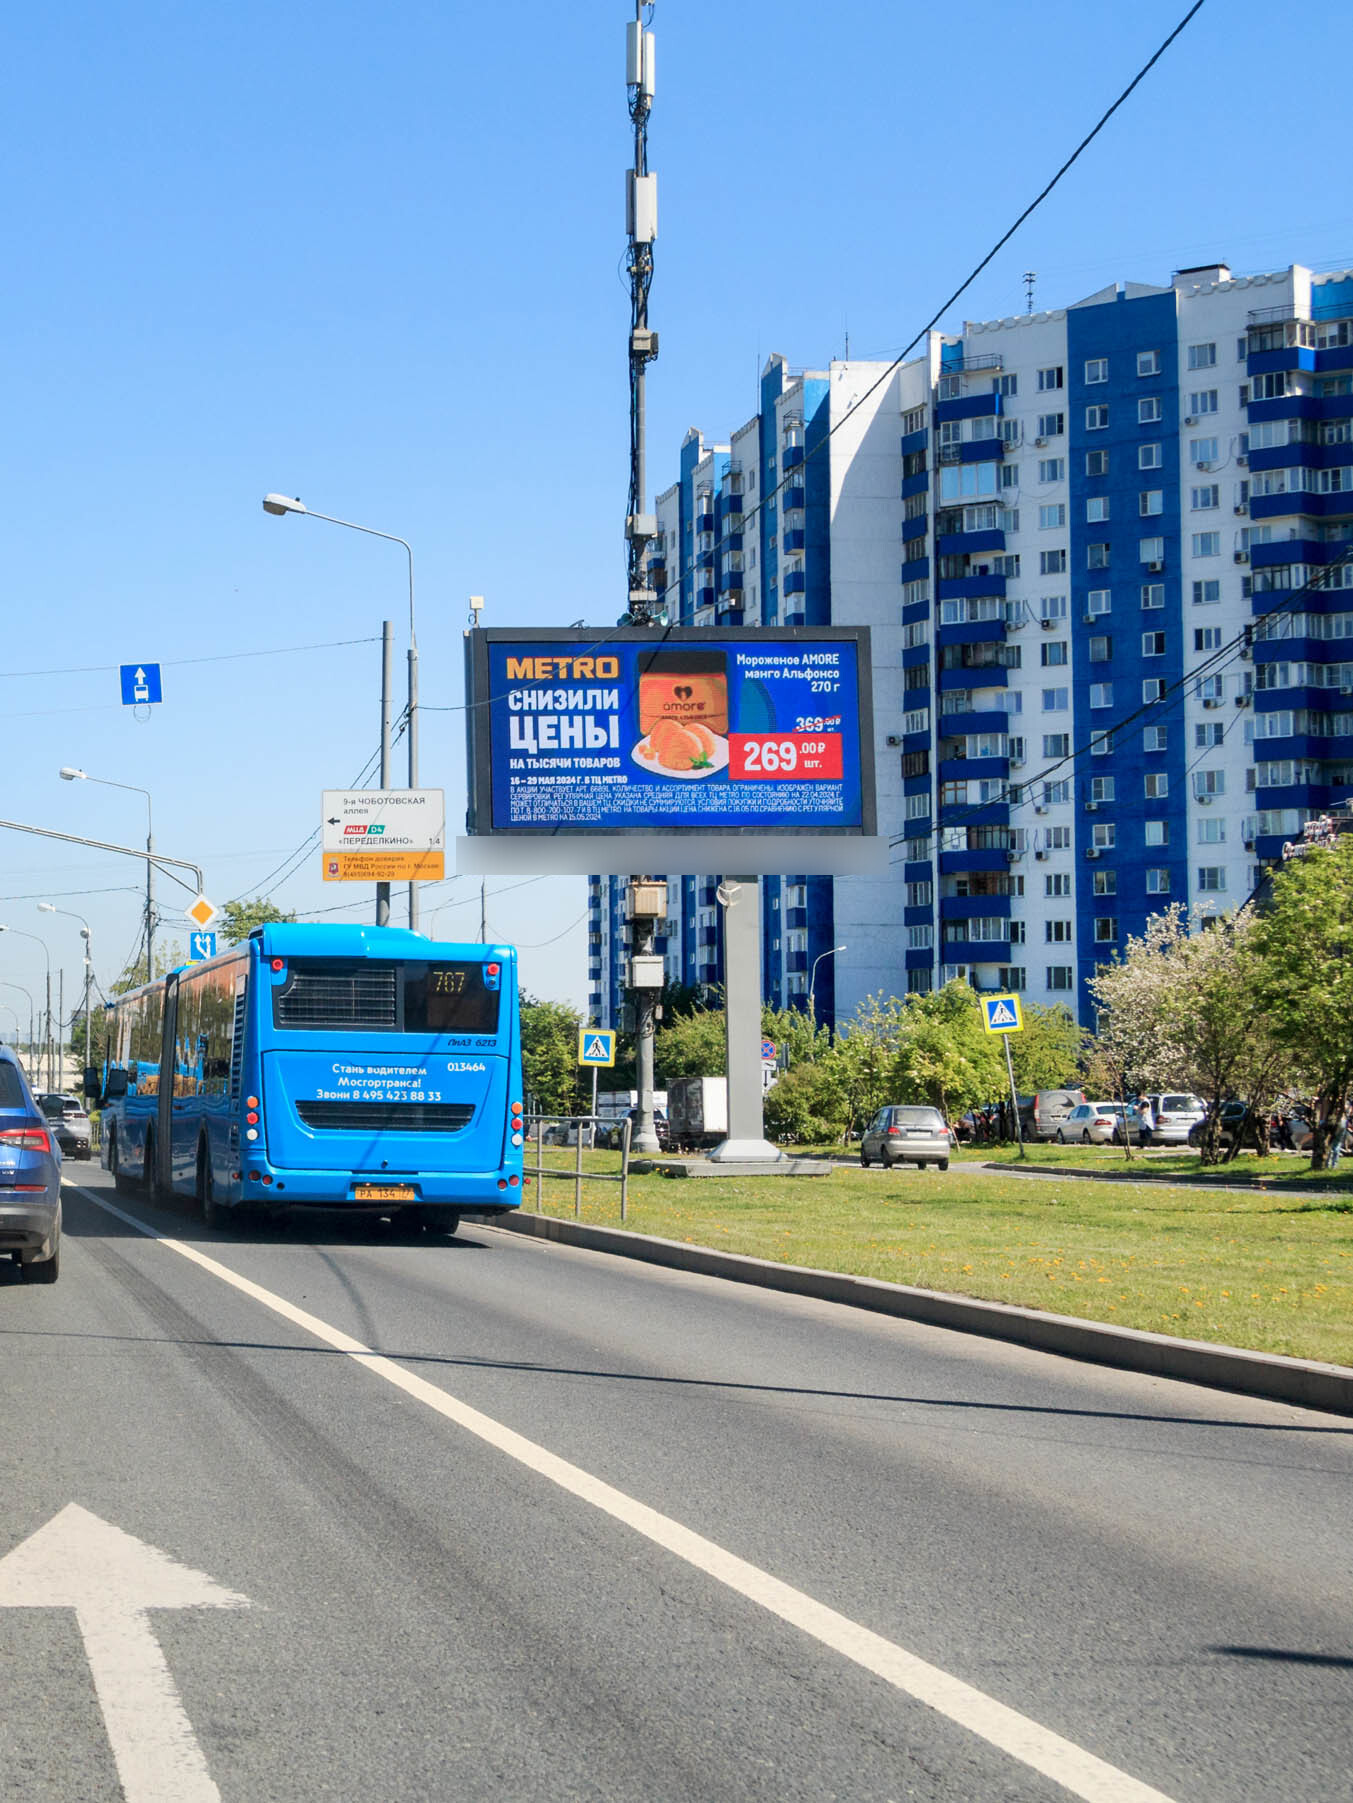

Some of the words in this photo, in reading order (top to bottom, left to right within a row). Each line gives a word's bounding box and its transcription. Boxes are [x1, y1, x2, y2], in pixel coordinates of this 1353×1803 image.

[736, 653, 800, 667] Мороженое
[801, 653, 840, 665] AMORE
[506, 656, 619, 680] METRO
[744, 669, 781, 679] манго
[782, 667, 840, 681] Альфонсо
[811, 681, 832, 692] 270
[833, 682, 840, 692] г
[508, 688, 619, 711] СНИЗИЛИ
[663, 702, 705, 711] amore
[795, 717, 823, 732] 369
[509, 715, 620, 755] ЦЕНЫ
[510, 758, 525, 769] НА
[526, 758, 572, 769] ТЫСЯЧИ
[573, 757, 621, 768] ТОВАРОВ
[743, 741, 797, 772] 269
[804, 760, 823, 768] шт.
[358, 797, 426, 805] ЧОБОТОВСКАЯ
[433, 971, 465, 993] 767
[447, 1038, 472, 1047] ЛиАЗ
[475, 1039, 497, 1048] 6213
[332, 1063, 364, 1074] Стань
[366, 1065, 427, 1076] водителем
[447, 1062, 486, 1072] 013464
[337, 1076, 422, 1089] Мосгортранса!
[316, 1088, 351, 1099] Звони
[352, 1089, 360, 1099] 8
[362, 1089, 384, 1100] 495
[386, 1089, 407, 1101] 423
[410, 1090, 425, 1101] 88
[427, 1090, 442, 1101] 33
